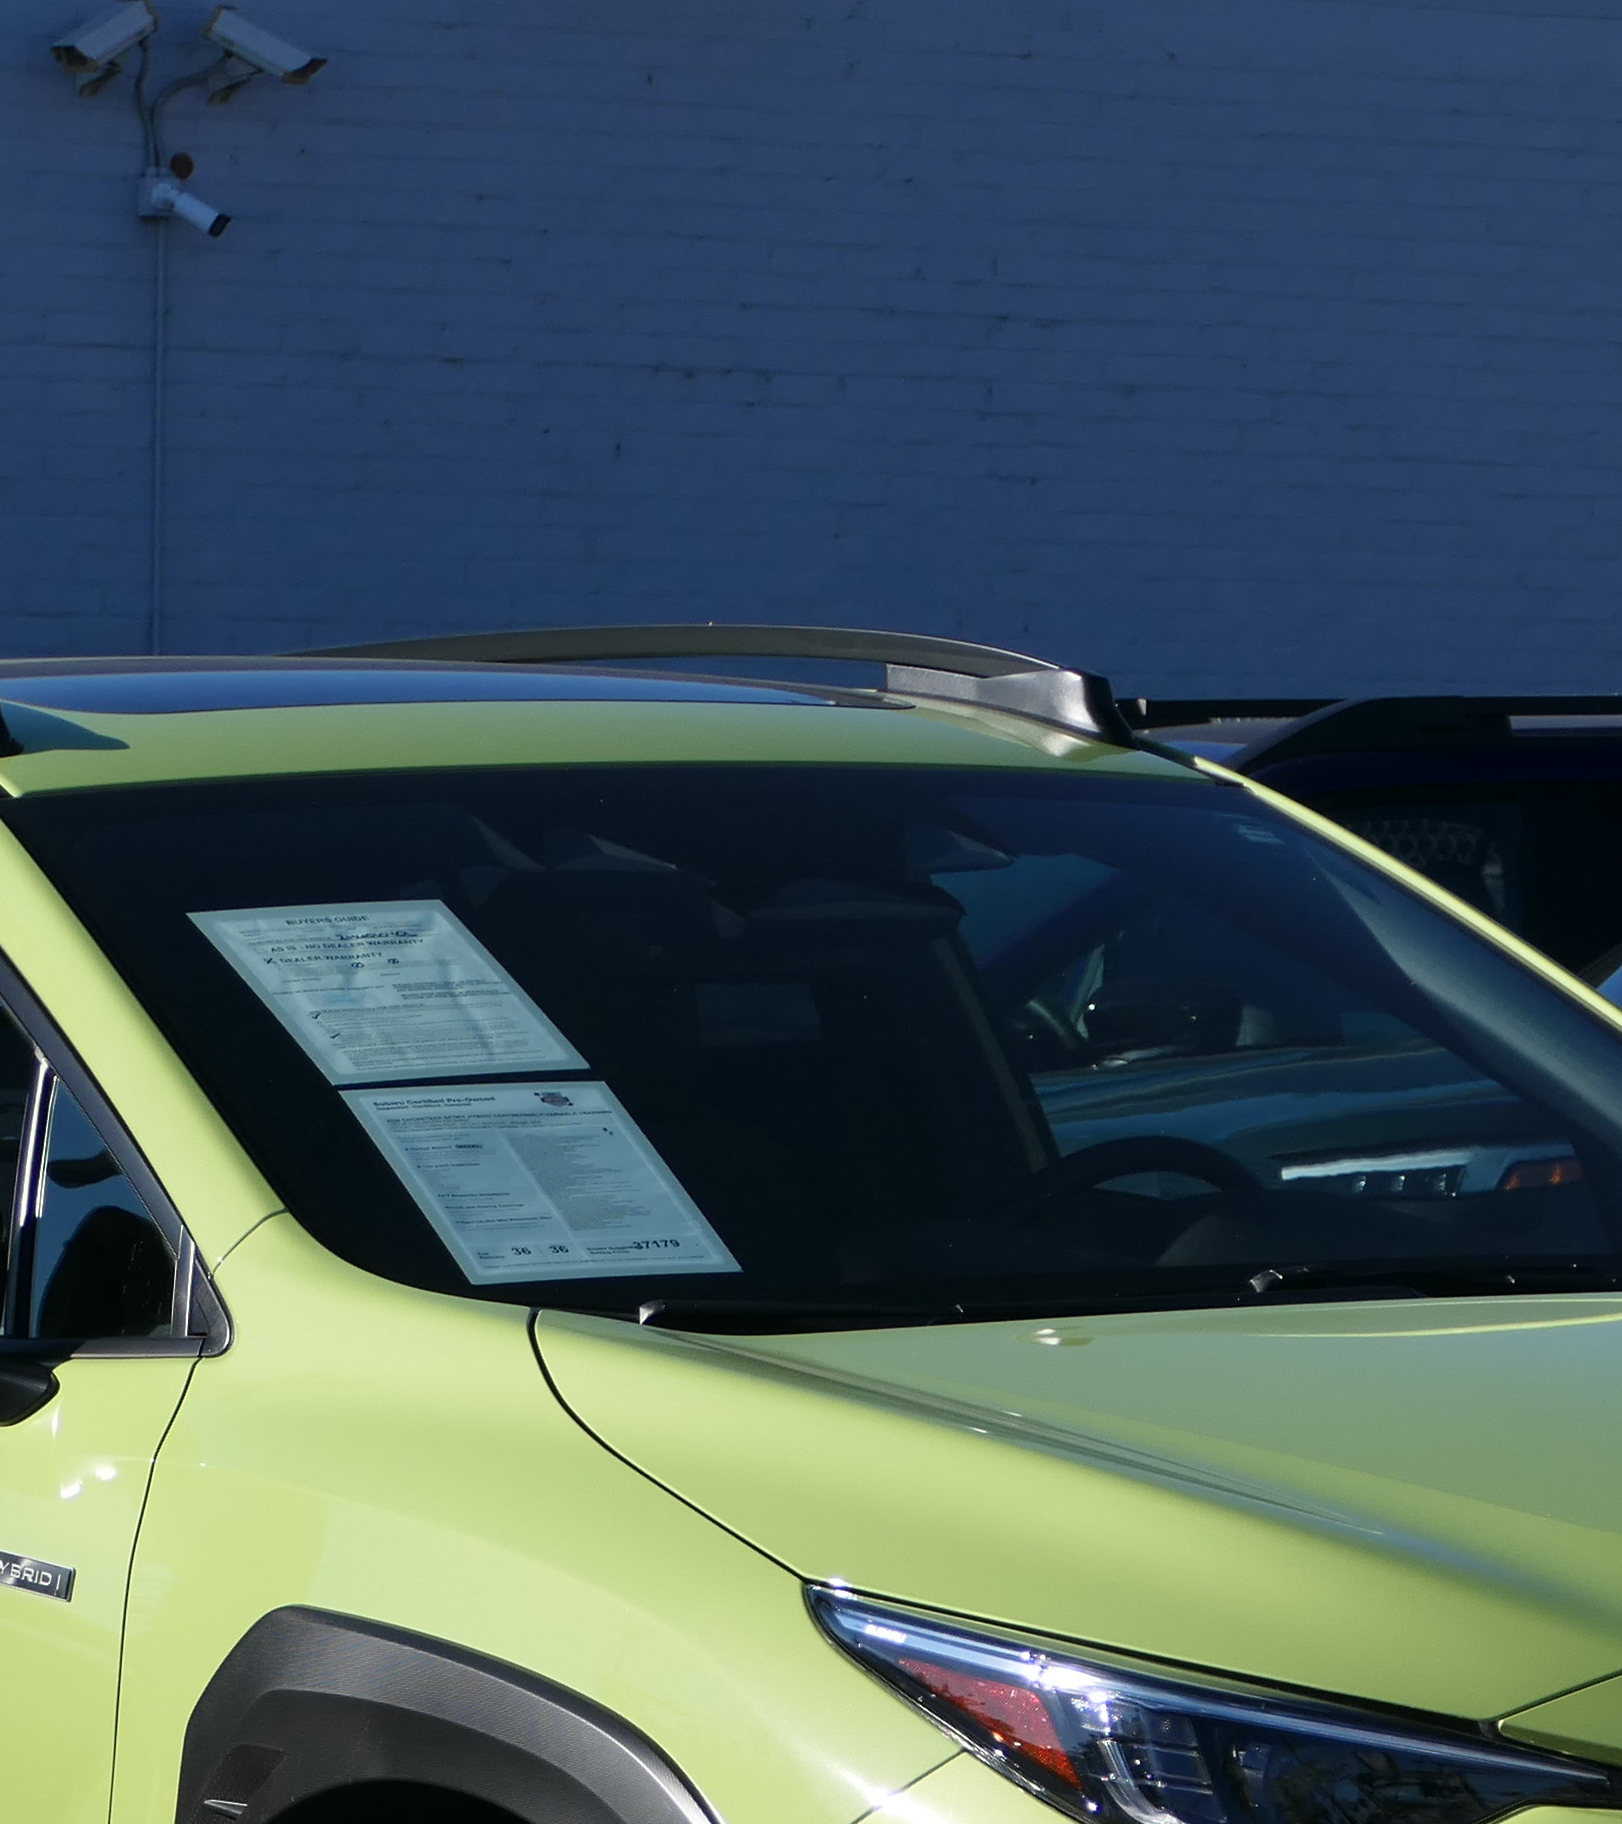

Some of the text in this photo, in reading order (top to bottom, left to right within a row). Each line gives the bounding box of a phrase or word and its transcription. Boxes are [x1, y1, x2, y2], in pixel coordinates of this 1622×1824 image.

[286, 914, 370, 926] BUYERS GUIDE
[323, 940, 367, 951] DEALER
[368, 937, 425, 947] WARRANTY
[279, 951, 384, 964] DEALER WARRANTY
[511, 1245, 532, 1257] 36
[548, 1244, 569, 1255] 36
